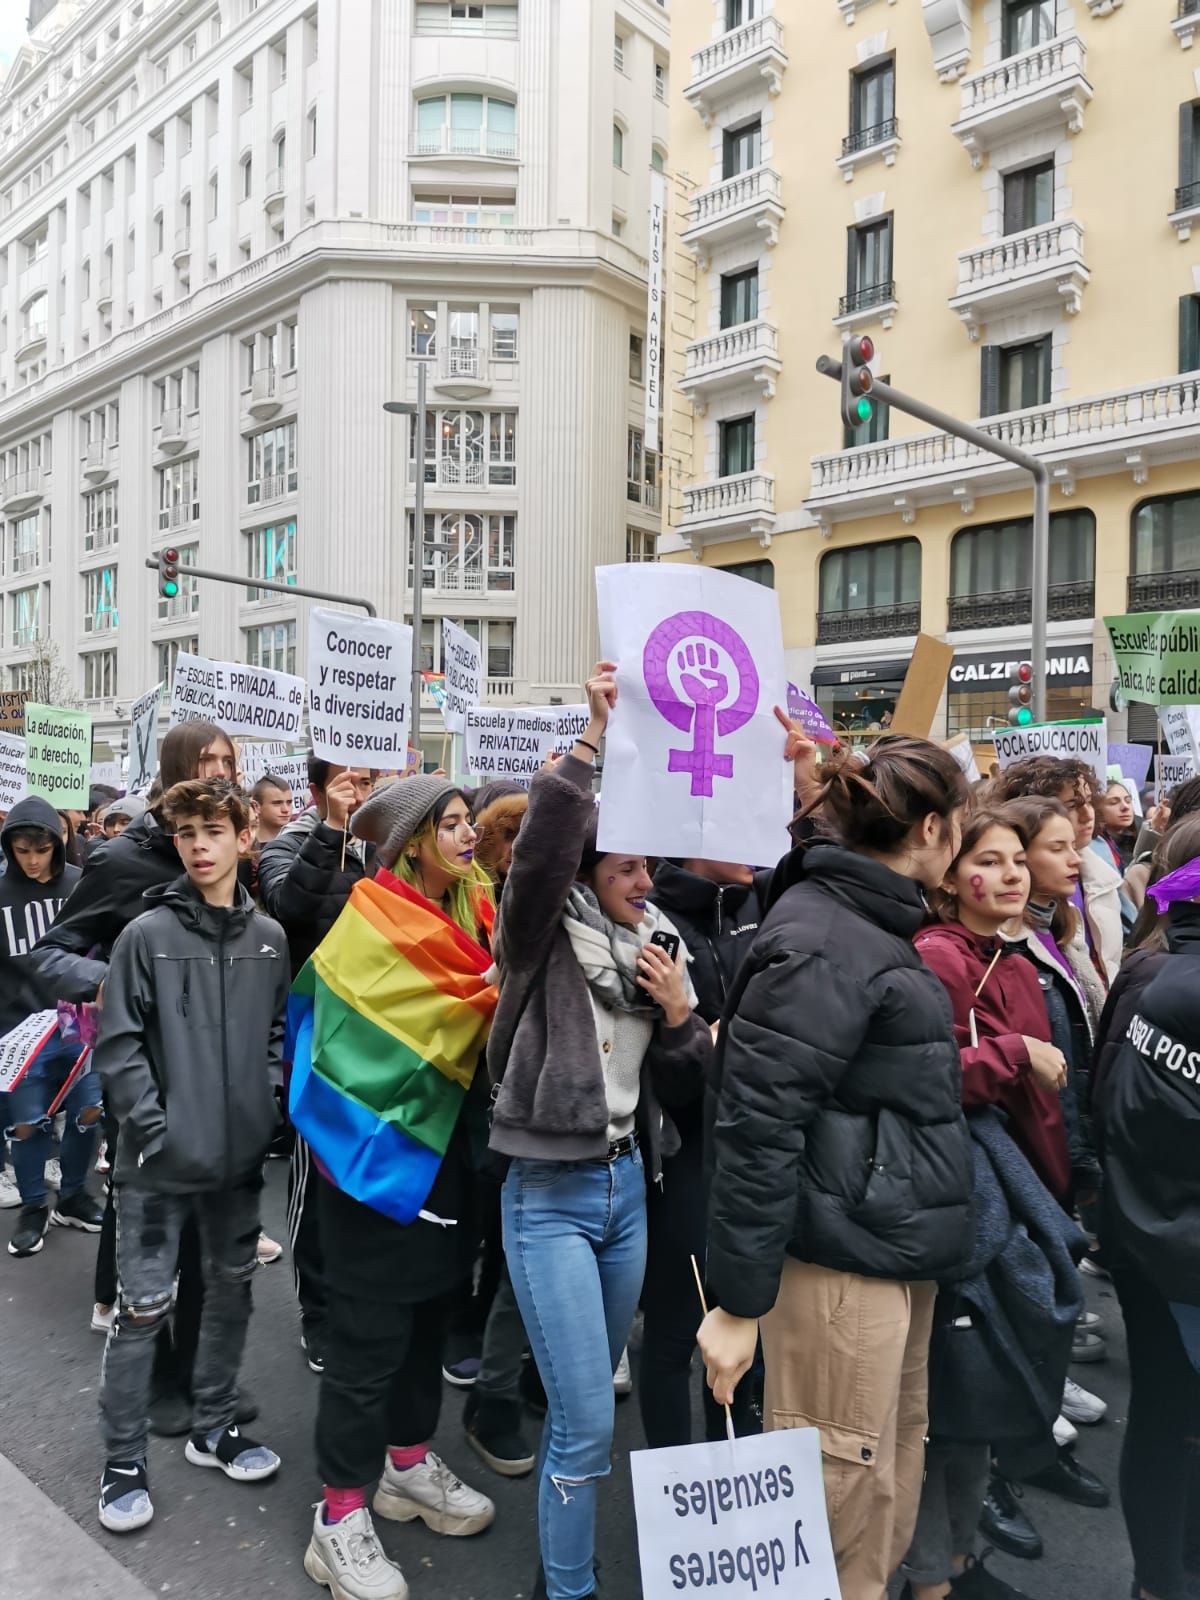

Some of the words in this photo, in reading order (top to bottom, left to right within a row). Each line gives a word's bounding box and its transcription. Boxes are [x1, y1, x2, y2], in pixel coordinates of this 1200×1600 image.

[652, 204, 660, 263] THIS
[651, 274, 658, 302] IS
[650, 312, 658, 325] A
[649, 334, 658, 408] HOTEL
[327, 631, 392, 660] Conocer
[319, 665, 328, 686] y
[333, 668, 396, 691] respetar
[950, 656, 1090, 682] CALZNIA
[1145, 667, 1155, 693] de
[1159, 669, 1200, 695] calid
[0, 693, 28, 707] ISMO
[175, 684, 216, 709] PÚBLICA
[216, 671, 227, 690] E.
[230, 673, 285, 701] PRIVADA...
[289, 687, 302, 706] de
[217, 701, 299, 733] SOLIDARIDAD!
[310, 689, 320, 711] la
[325, 693, 404, 722] diversidad
[27, 716, 36, 733] La
[38, 720, 86, 744] educación,
[468, 712, 505, 729] Escuela
[507, 718, 514, 732] y
[517, 716, 555, 732] medios:
[0, 743, 25, 759] ducar
[313, 726, 326, 744] en
[330, 725, 341, 746] lo
[346, 733, 401, 752] sexual.
[480, 735, 540, 752] PRIVATIZAN
[995, 736, 1025, 759] POCA
[1028, 725, 1101, 755] EDUCACIÓN,
[29, 746, 38, 760] un
[42, 745, 82, 768] derecho,
[470, 756, 495, 771] PARA
[37, 773, 85, 792] negocio!
[1153, 1035, 1200, 1085] POS
[664, 1464, 794, 1524] sexuales.
[795, 1520, 810, 1567] y
[669, 1537, 785, 1591] deberes
